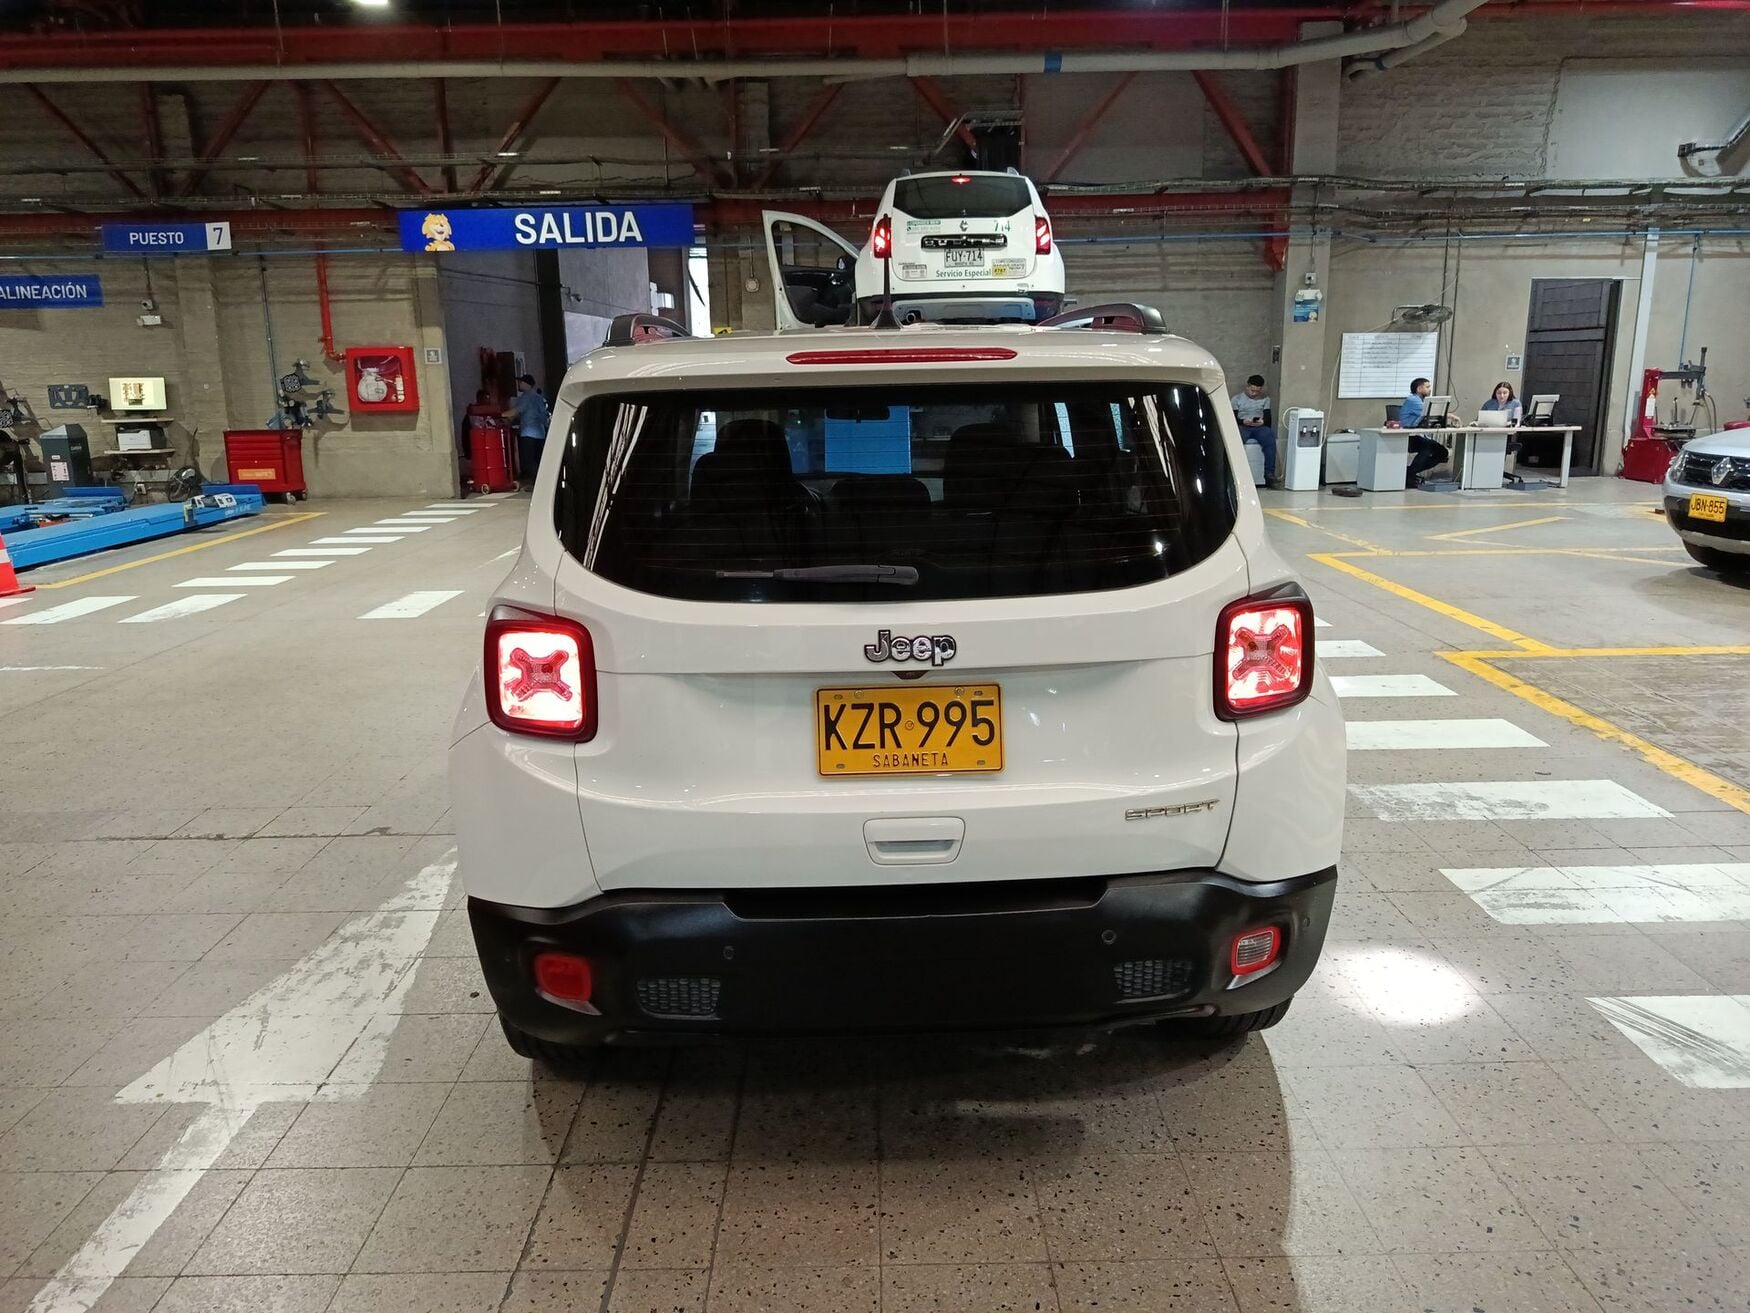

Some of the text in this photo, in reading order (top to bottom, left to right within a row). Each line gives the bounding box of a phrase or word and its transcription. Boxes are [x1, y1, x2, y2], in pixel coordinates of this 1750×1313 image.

[129, 226, 223, 245] PUESTO 7
[514, 211, 643, 244] SALIDA
[936, 269, 963, 278] Servicio
[964, 269, 991, 278] Especial
[0, 282, 87, 299] ALINEACIÓN
[864, 629, 957, 667] Jeep
[823, 700, 995, 751] KZR 995
[873, 752, 949, 769] SABANETA
[1125, 799, 1220, 821] SPORT
